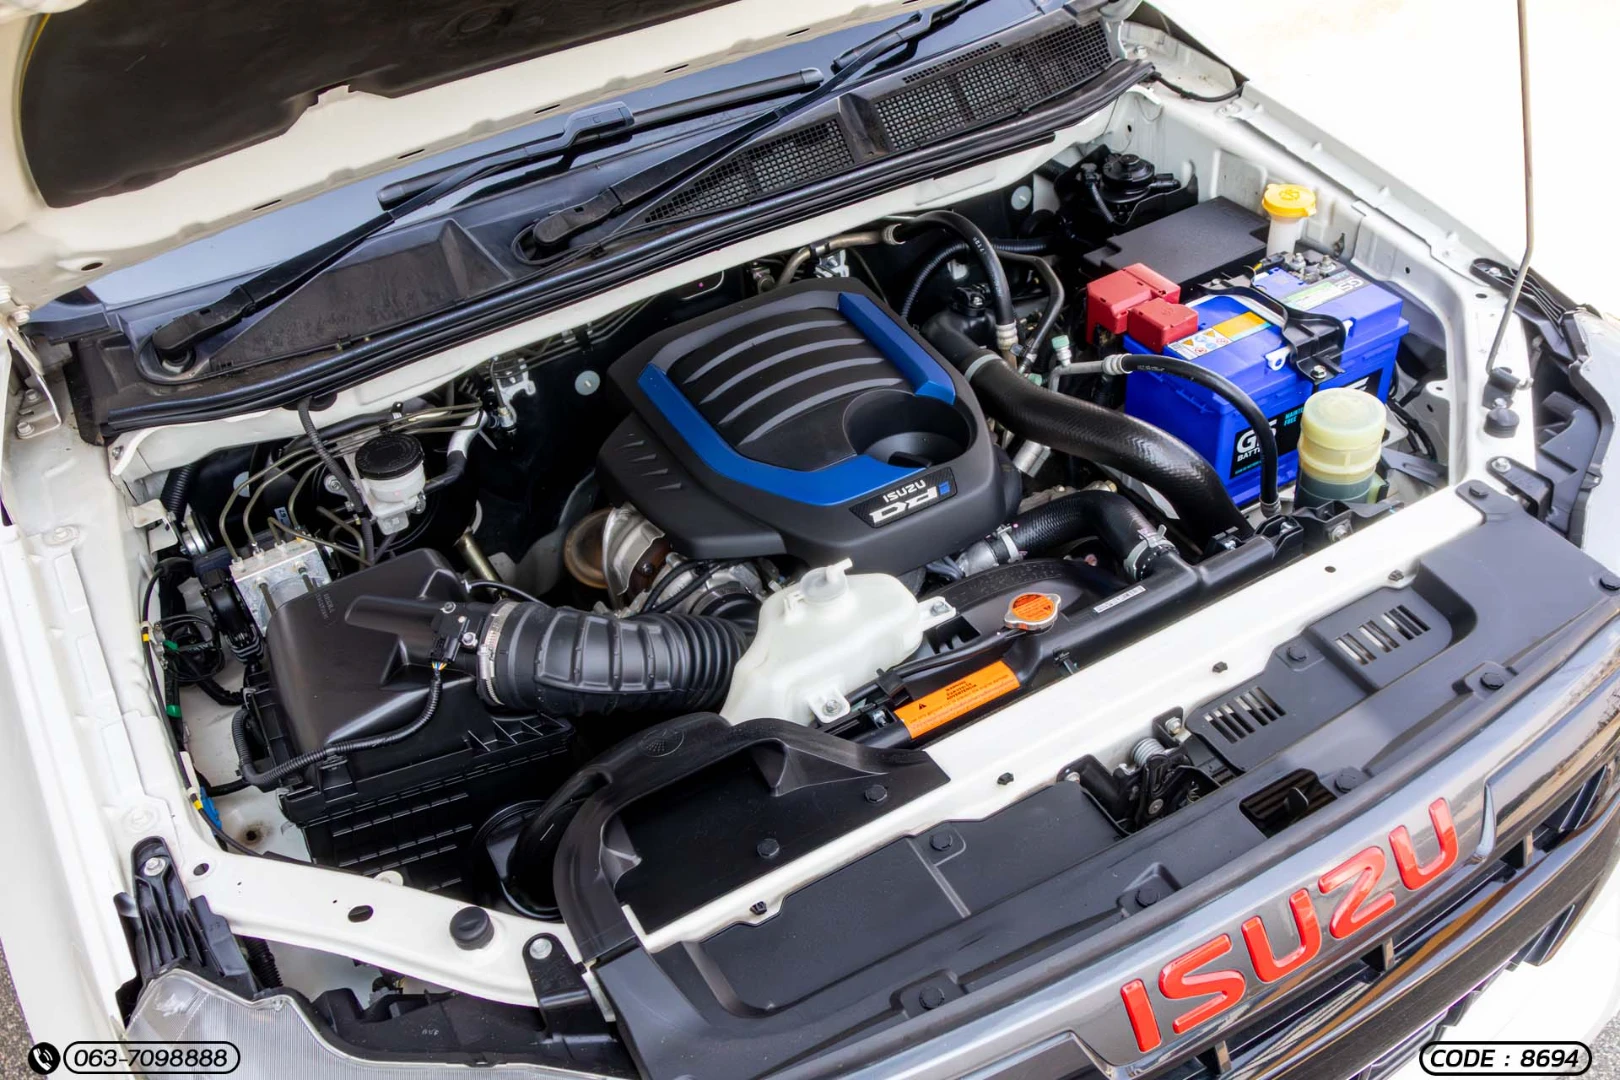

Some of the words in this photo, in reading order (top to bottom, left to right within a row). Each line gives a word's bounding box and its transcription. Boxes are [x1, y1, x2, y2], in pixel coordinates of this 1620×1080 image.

[1237, 447, 1261, 462] BATT
[883, 480, 926, 503] ISUZU
[1120, 797, 1459, 1053] ISUZU
